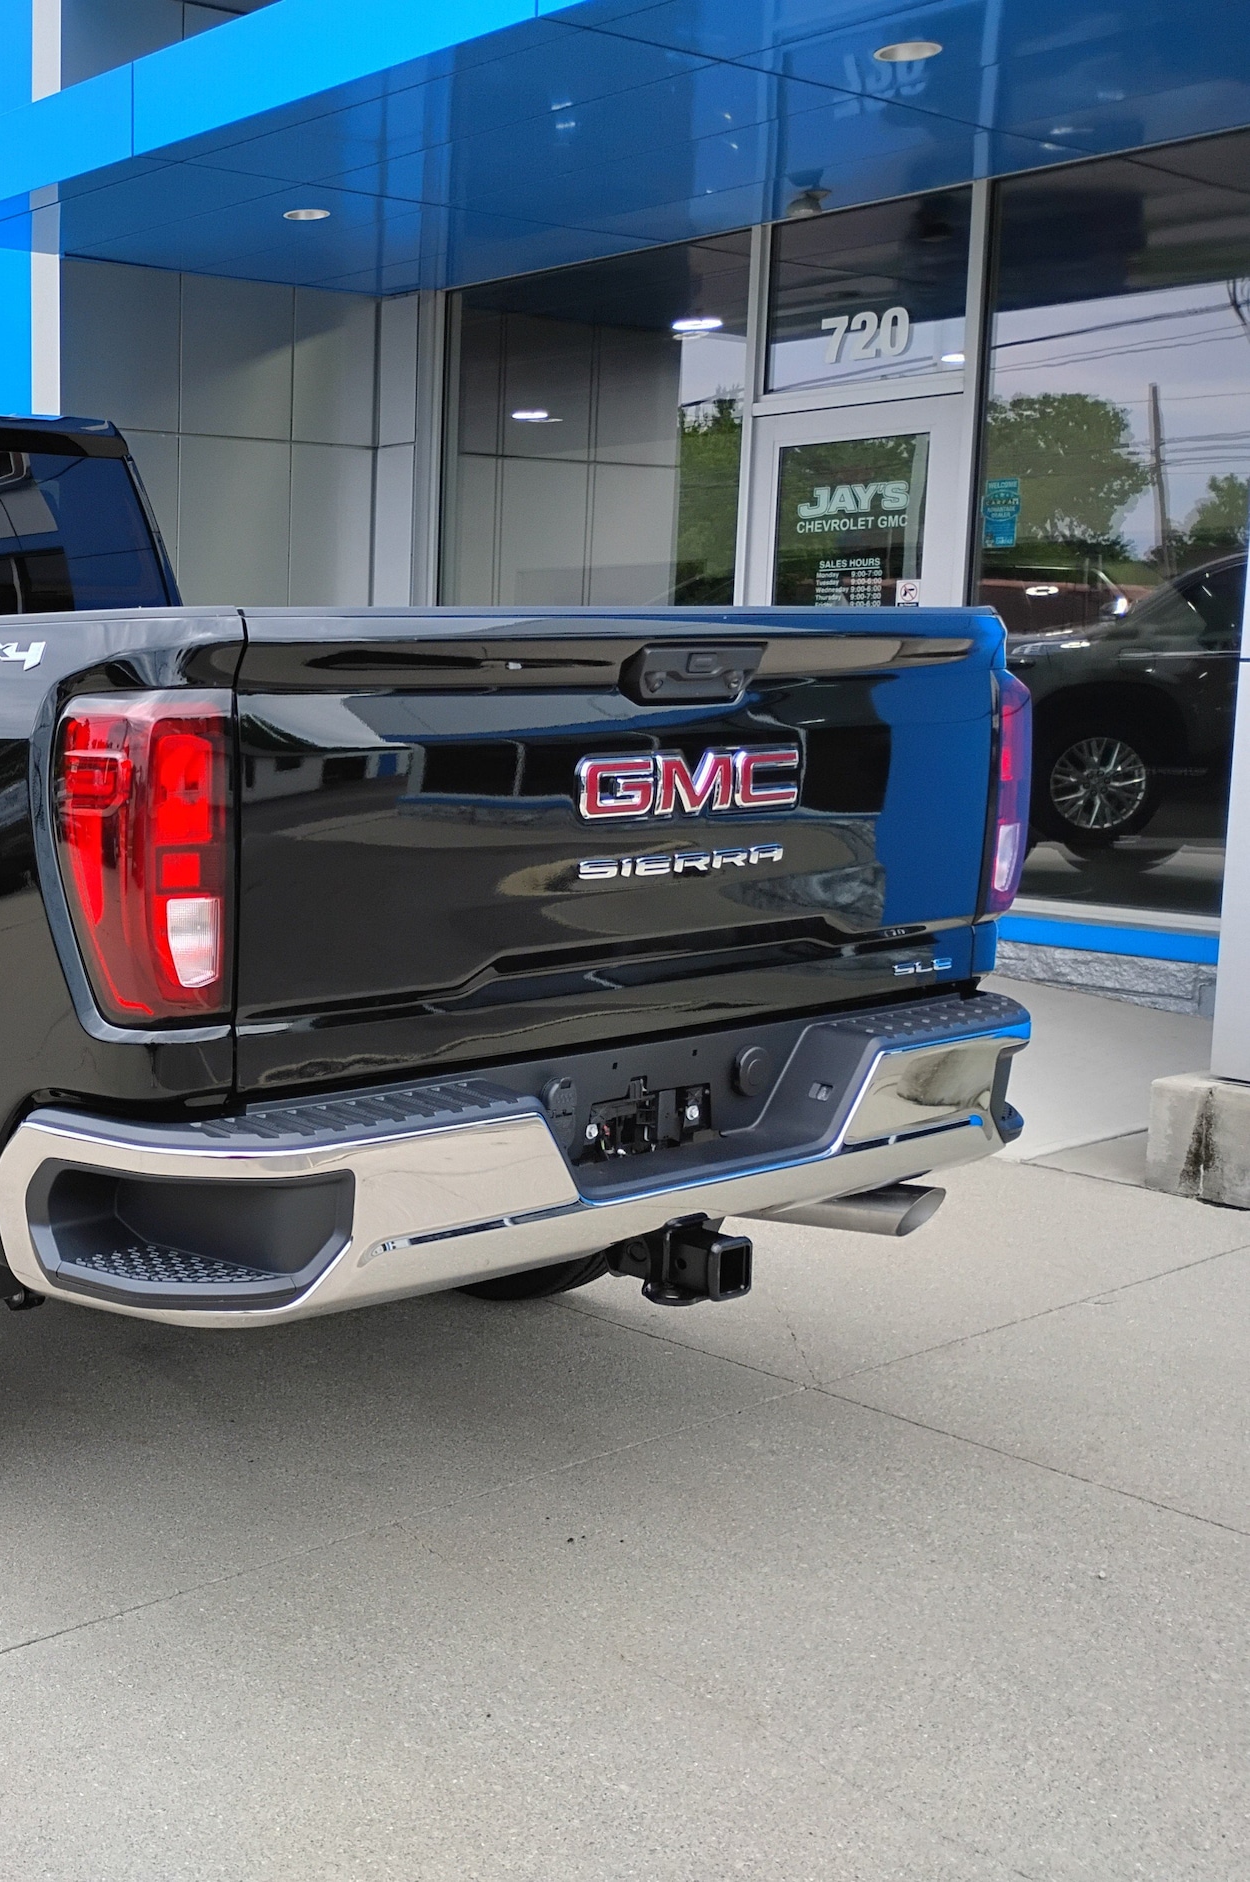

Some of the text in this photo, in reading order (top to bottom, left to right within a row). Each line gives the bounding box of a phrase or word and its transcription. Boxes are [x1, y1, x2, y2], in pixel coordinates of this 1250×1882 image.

[821, 306, 913, 364] 720
[797, 480, 910, 519] JAY'S
[796, 514, 908, 534] CHEVROLET GMC
[819, 558, 881, 569] SALES HOURS
[578, 746, 799, 820] GMC
[578, 842, 784, 880] SIERRA
[892, 957, 953, 976] SLE
